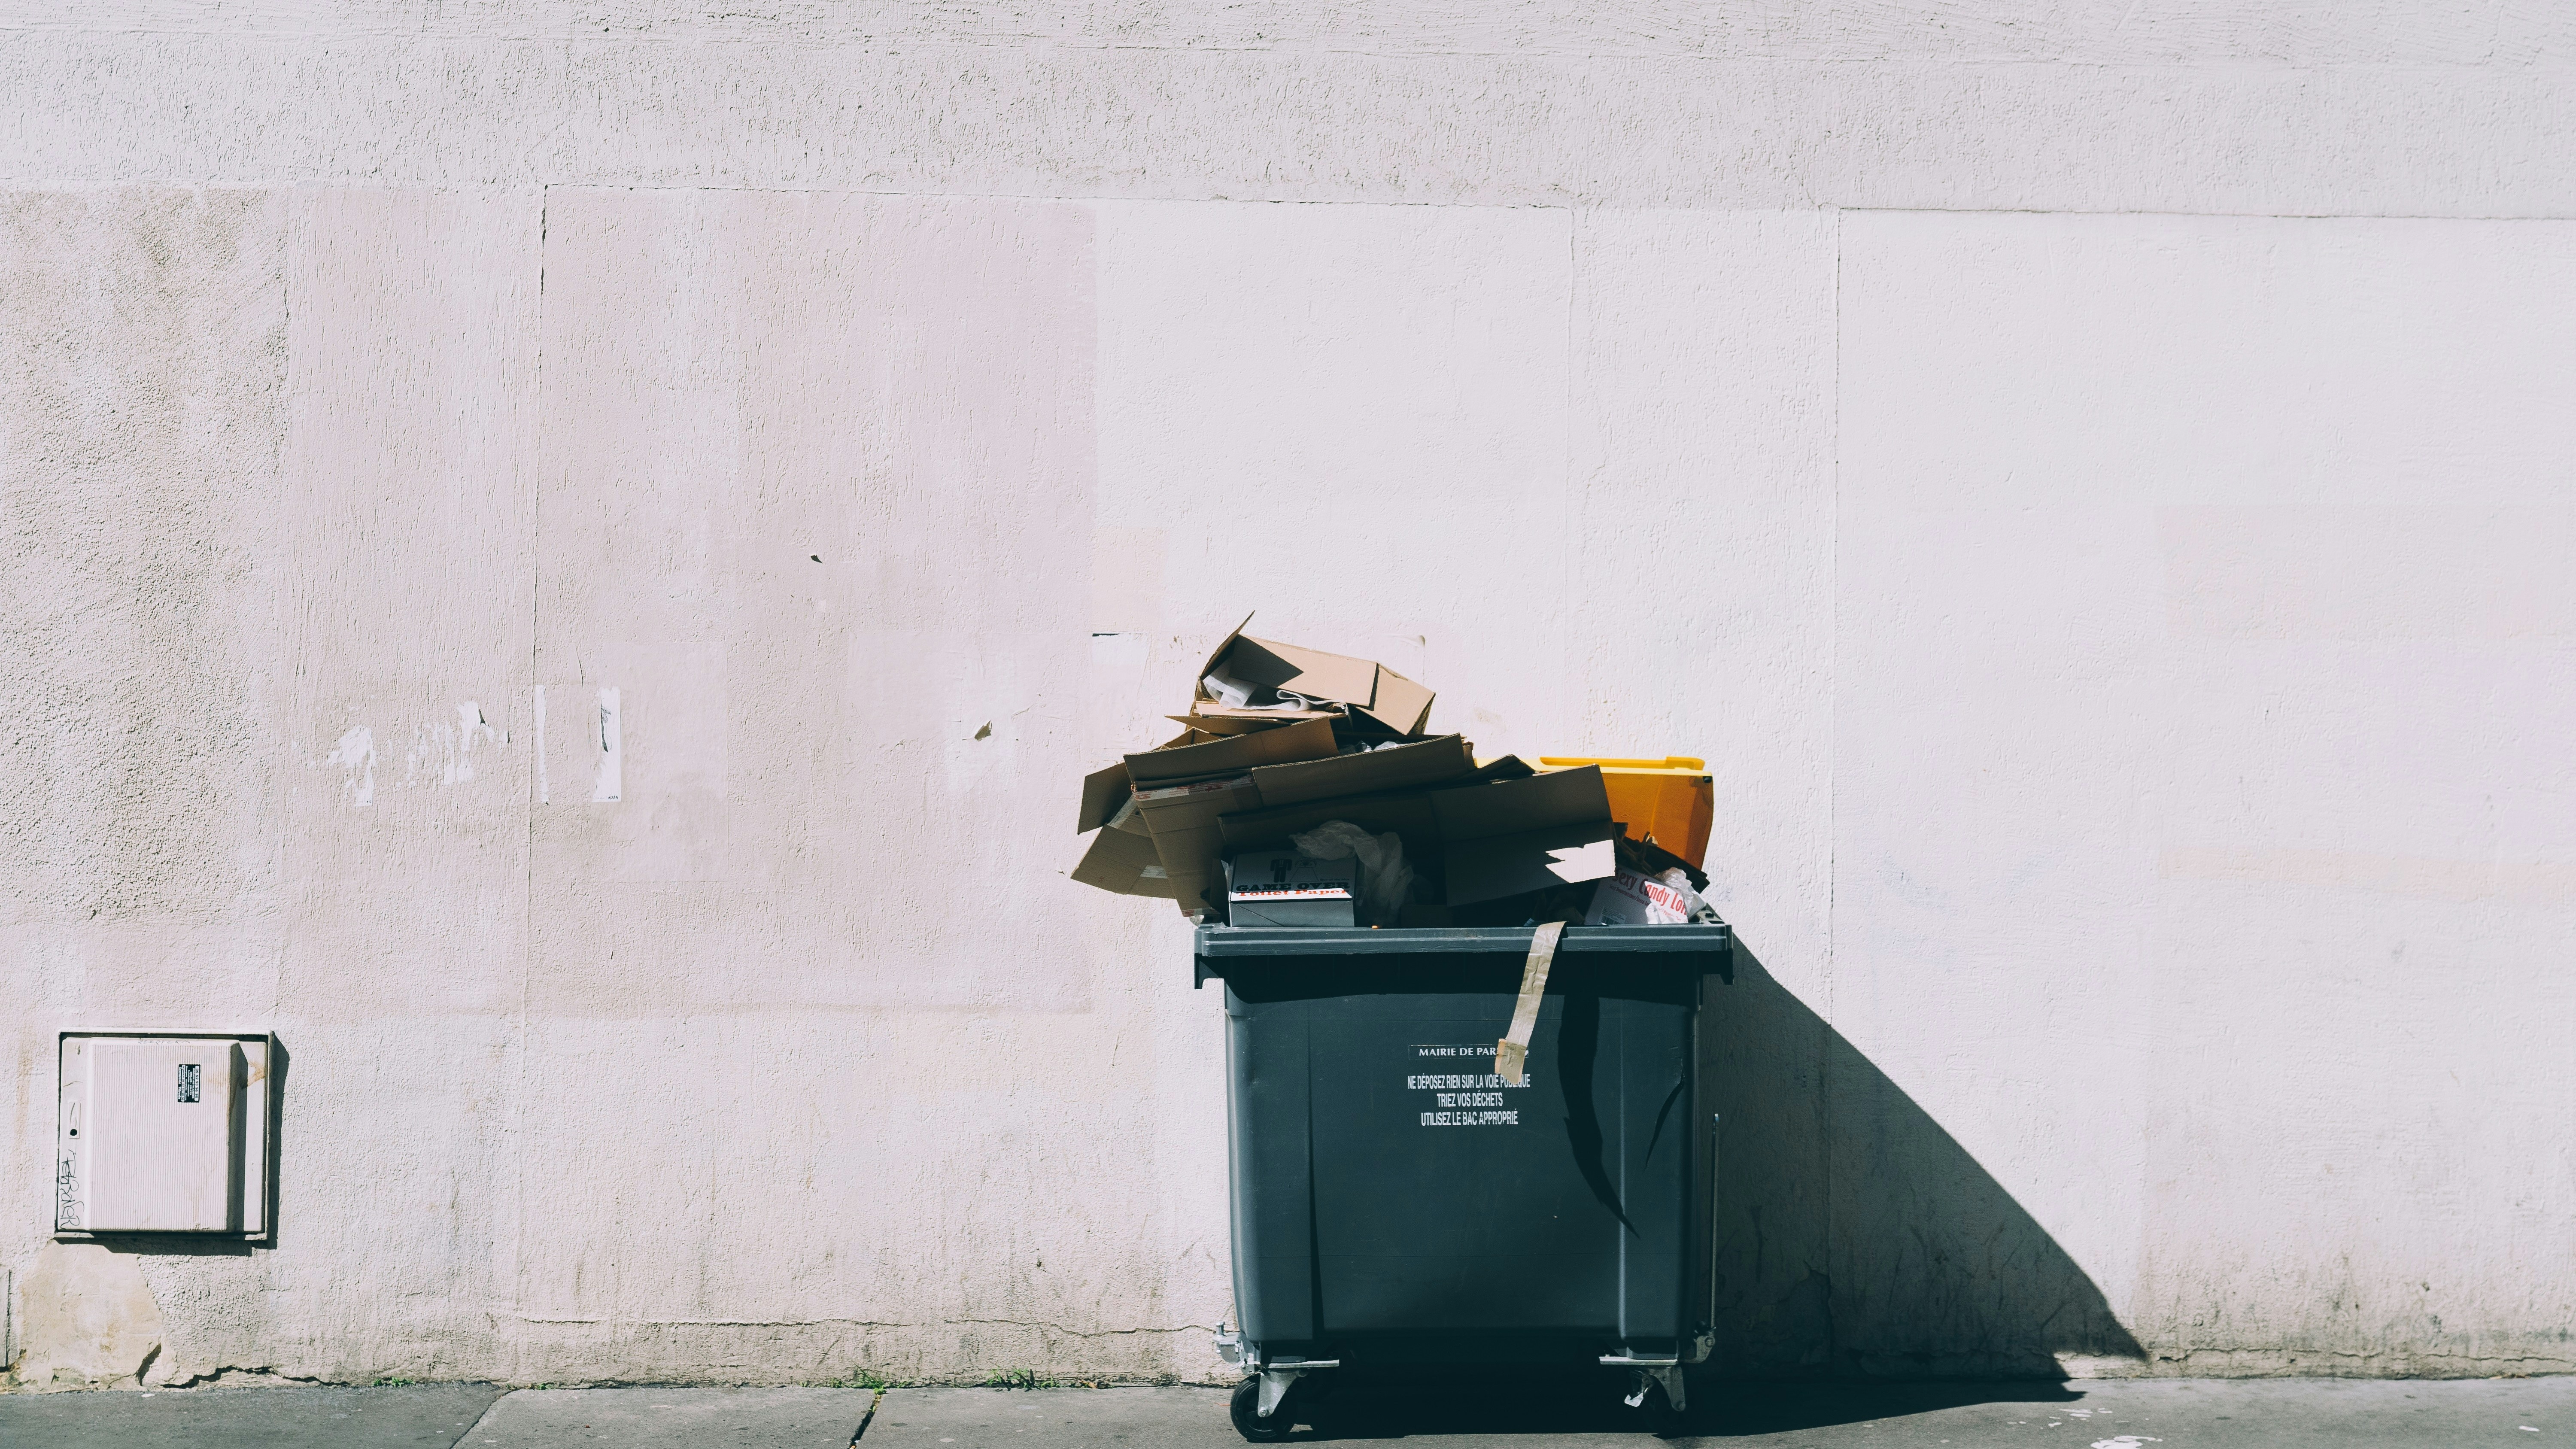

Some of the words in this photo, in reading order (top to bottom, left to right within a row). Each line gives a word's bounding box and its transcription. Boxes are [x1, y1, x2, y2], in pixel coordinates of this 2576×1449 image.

[1236, 883, 1291, 892] GAME
[1612, 867, 1638, 890] Sexy
[1639, 878, 1670, 906] Candy
[1419, 1048, 1456, 1056] MAIRIE
[1477, 1048, 1496, 1056] PAR
[1408, 1075, 1416, 1089] NE
[1417, 1073, 1445, 1089] DÉPOSEZ
[1446, 1075, 1461, 1089] RIEN
[1462, 1075, 1474, 1088] SUR
[1476, 1074, 1484, 1088] LA
[1485, 1074, 1499, 1088] VOIE
[1500, 1074, 1530, 1088] PUUE
[1437, 1093, 1456, 1107] TRIEZ
[1457, 1093, 1471, 1107] VOS
[1473, 1090, 1503, 1107] DÉCHETS
[1421, 1112, 1451, 1126] UTILISEZ
[1452, 1112, 1461, 1125] LE
[1462, 1112, 1477, 1125] BAC
[1479, 1109, 1518, 1125] APPROPRIÉ
